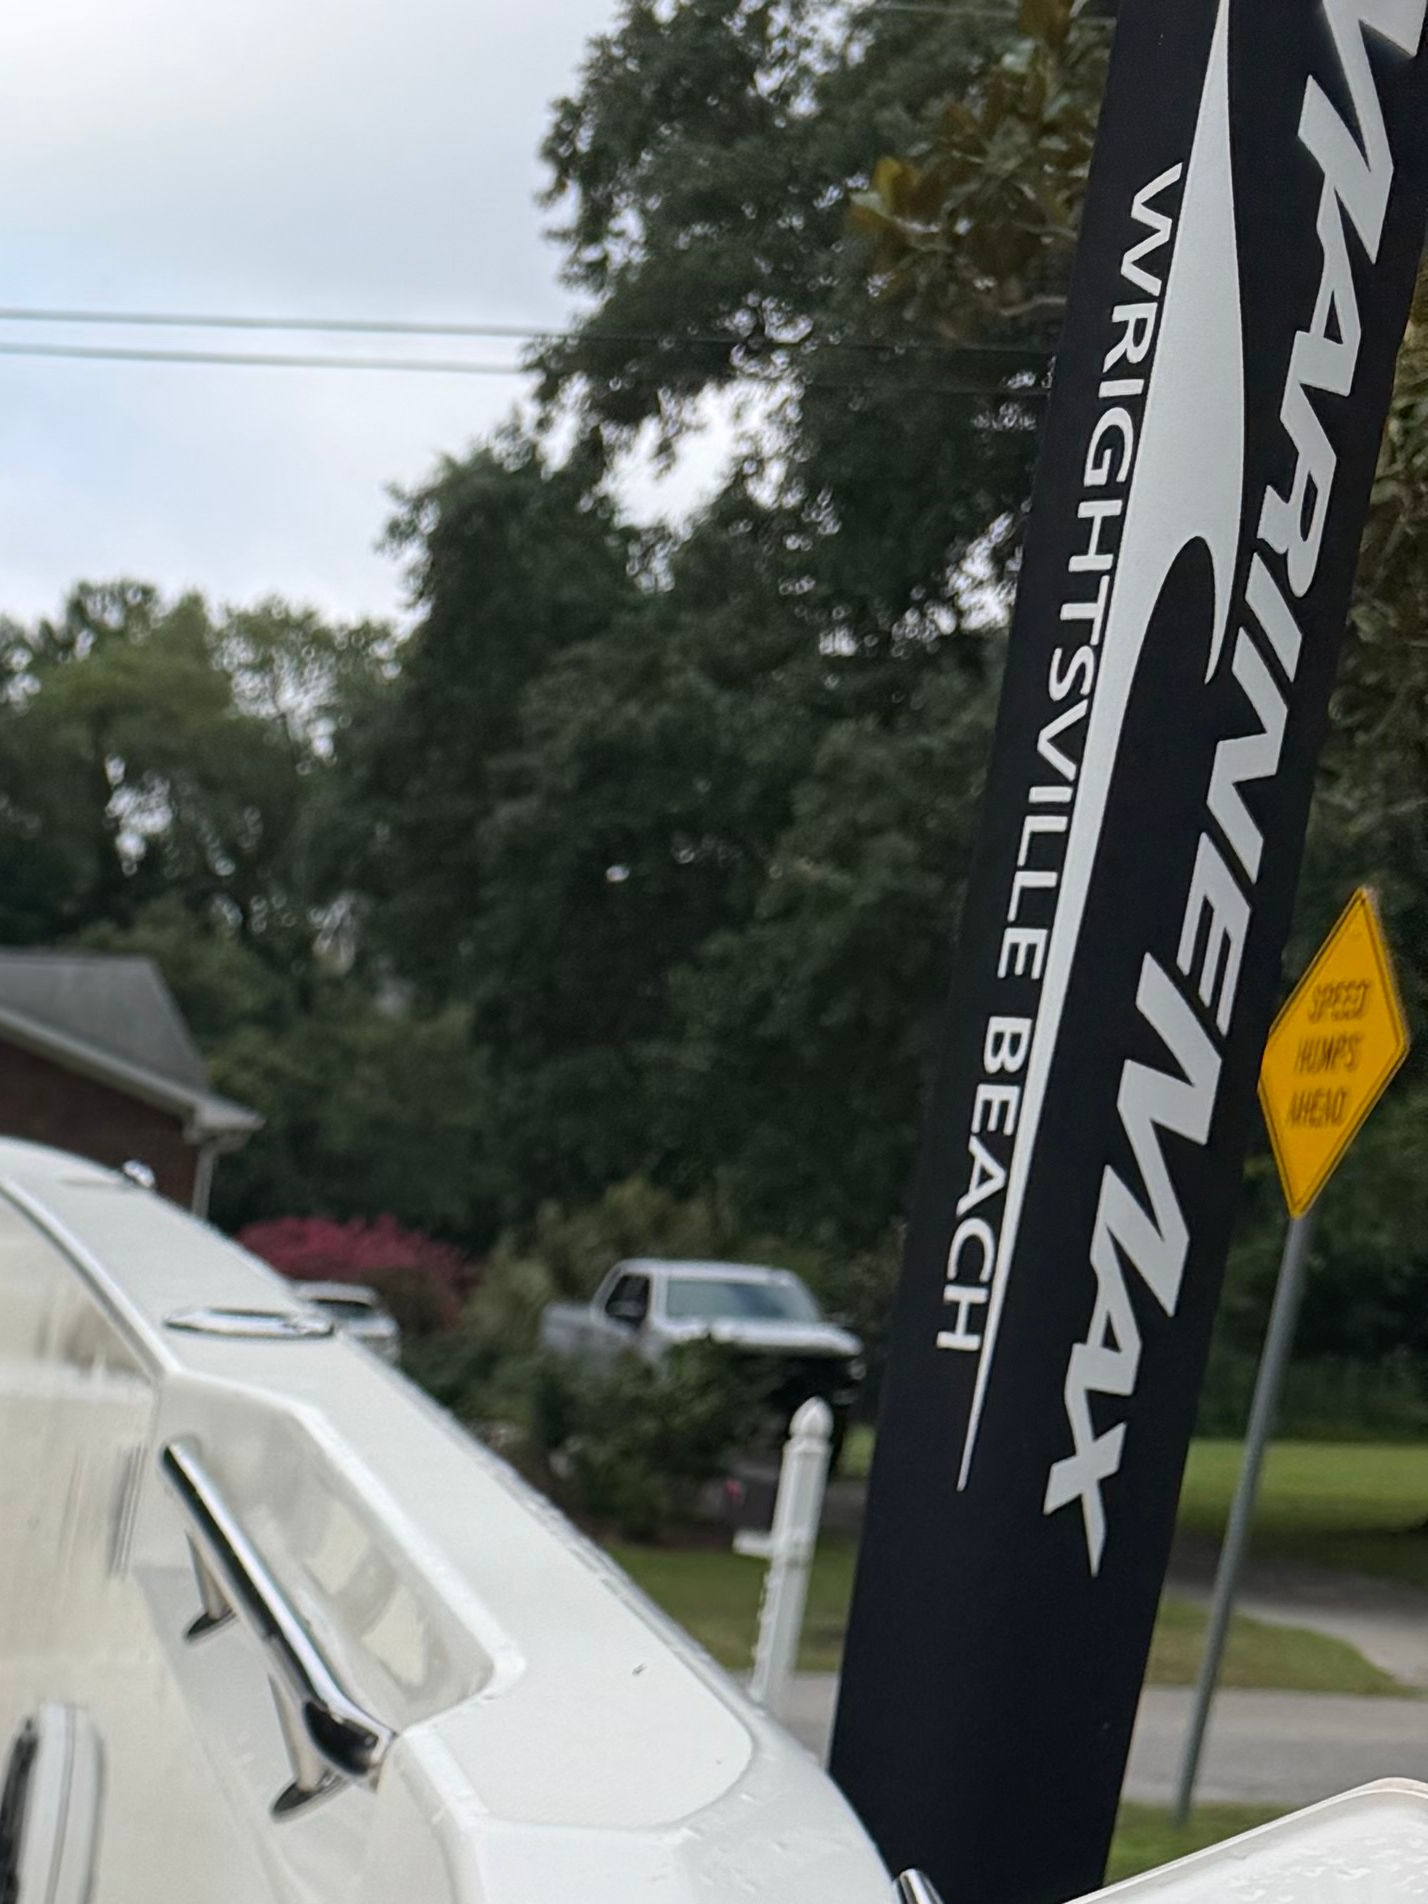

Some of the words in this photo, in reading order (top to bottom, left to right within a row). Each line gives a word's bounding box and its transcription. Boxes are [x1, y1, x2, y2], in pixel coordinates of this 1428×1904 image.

[996, 162, 1183, 980] WRIGHTSVILLE
[1295, 1033, 1364, 1073] HUMPS
[1307, 979, 1372, 1024] SPEED
[936, 1016, 1031, 1351] BEACH
